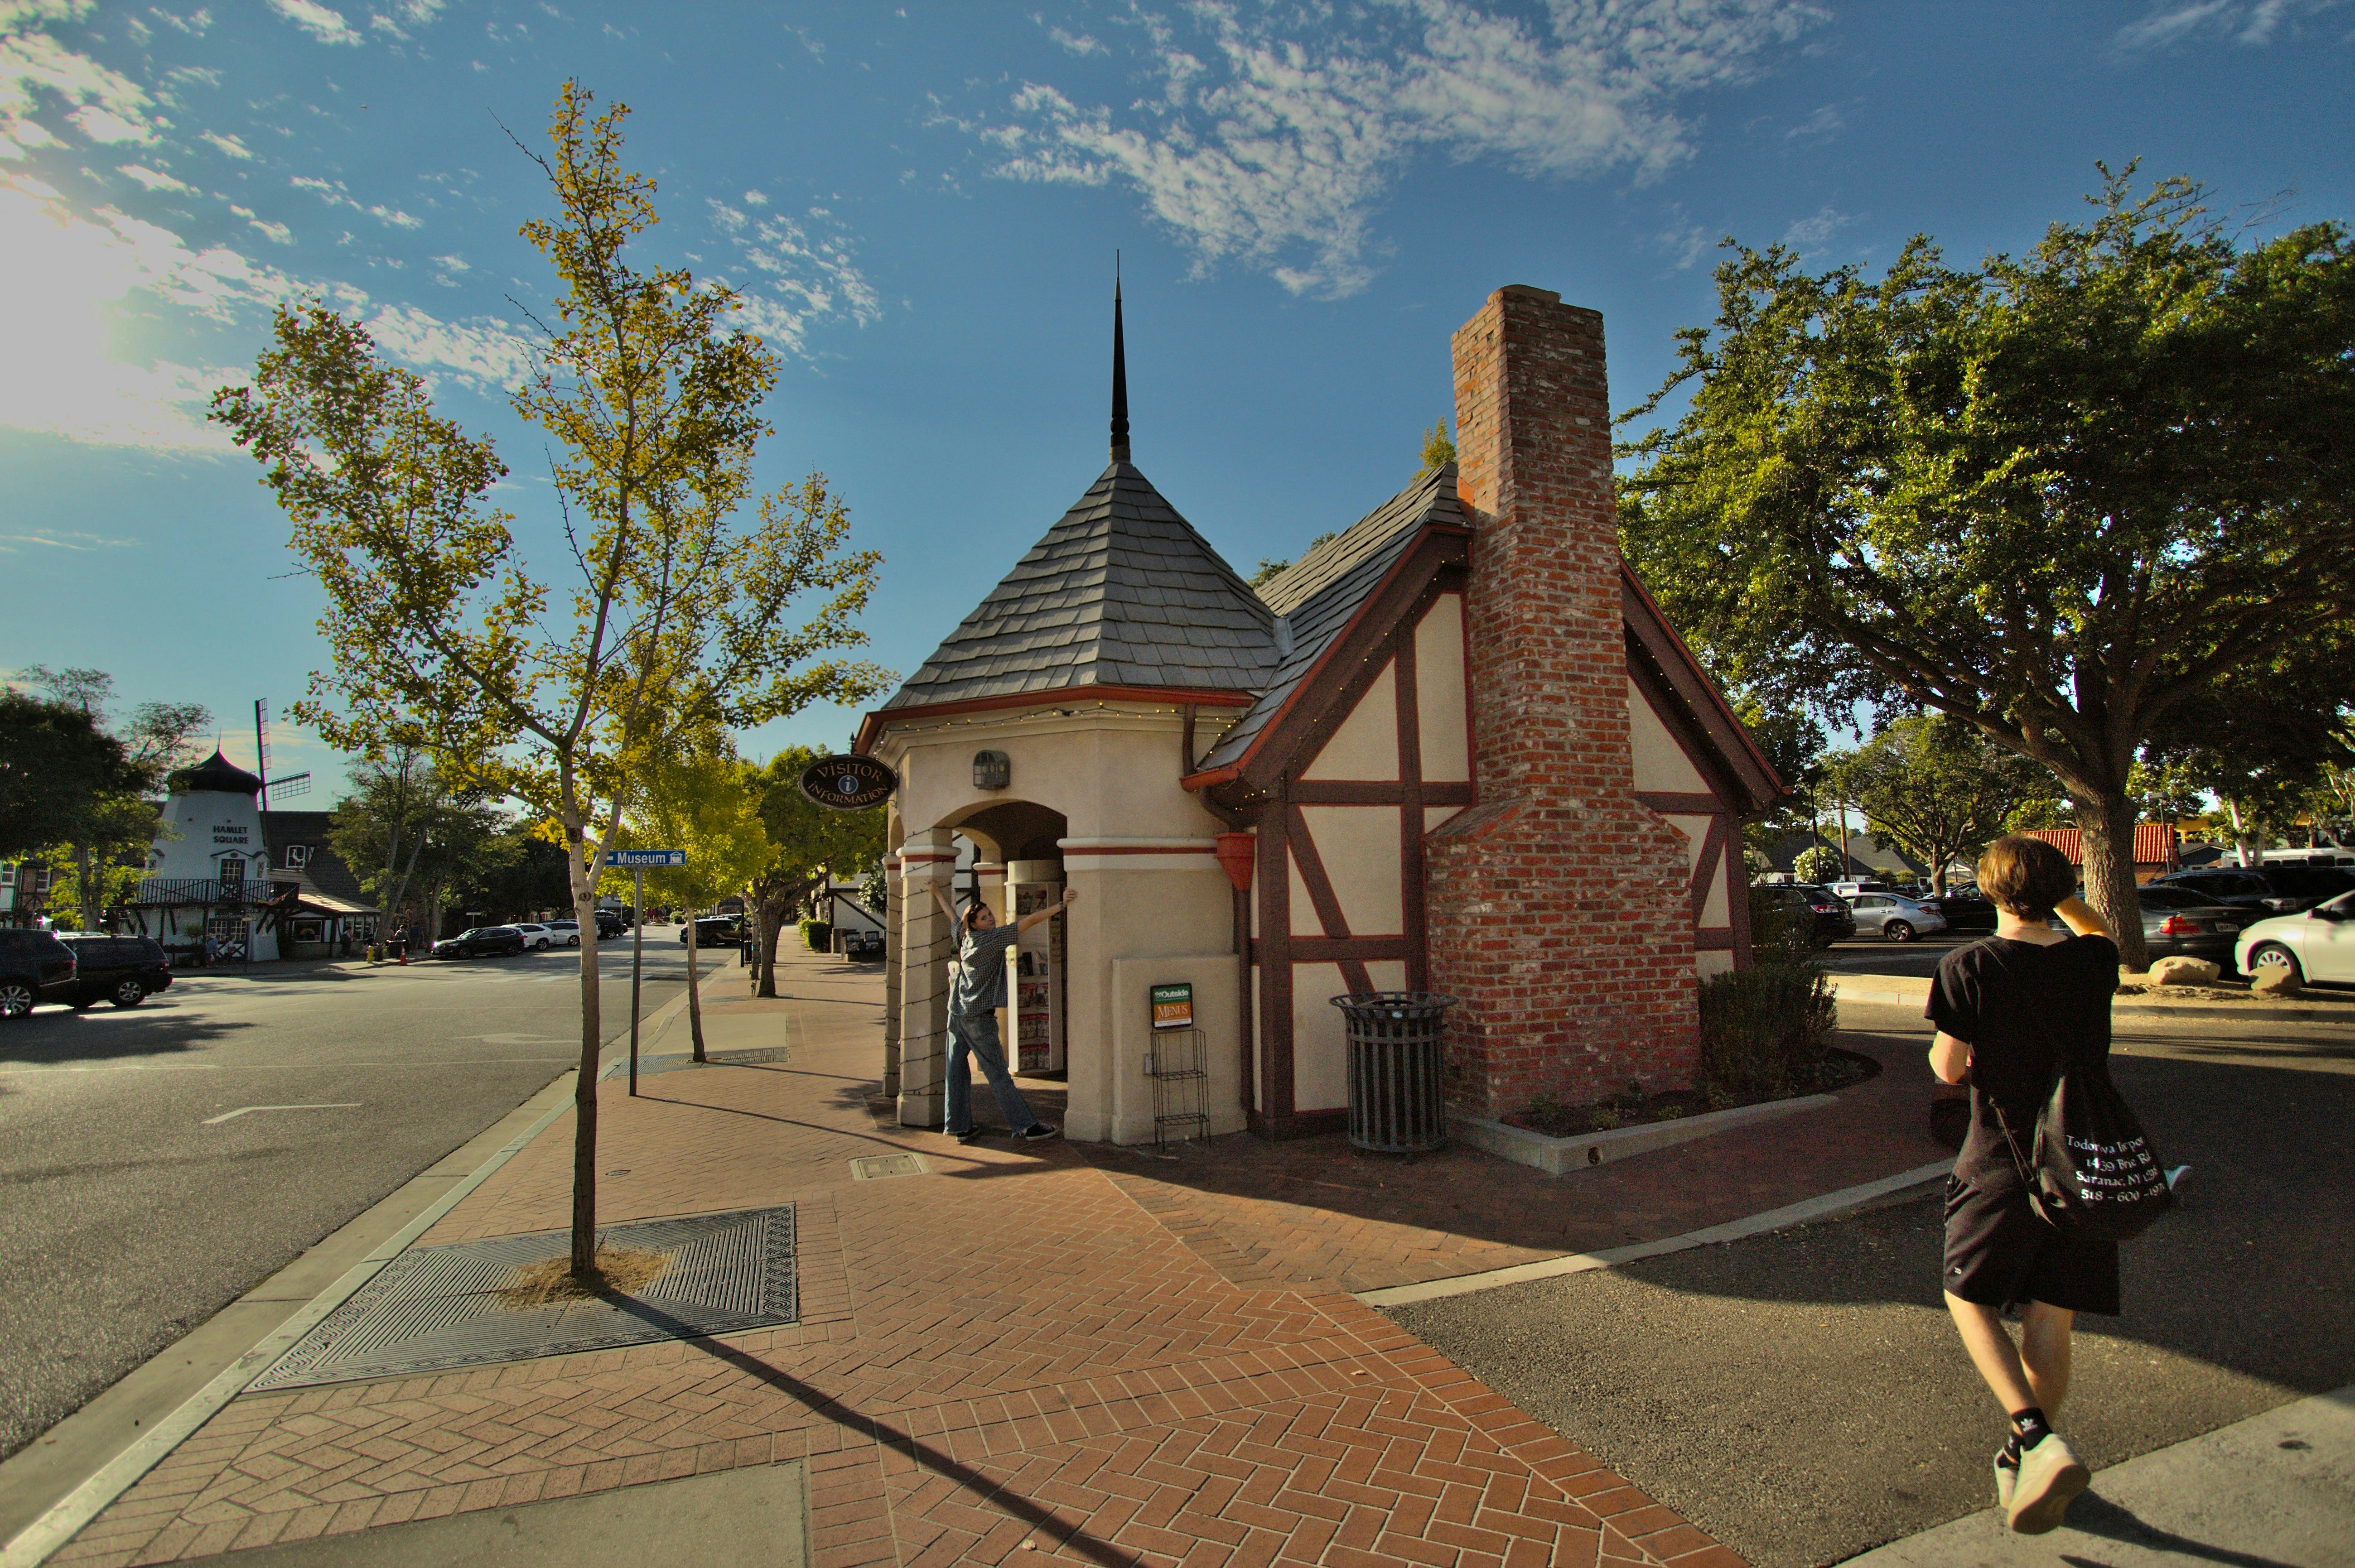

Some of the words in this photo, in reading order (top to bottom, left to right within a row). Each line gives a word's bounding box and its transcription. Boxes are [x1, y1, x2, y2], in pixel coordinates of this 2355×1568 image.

[817, 761, 882, 782] VISITOR
[808, 781, 888, 803] INFORMATION
[213, 825, 248, 833] HAMLET
[213, 836, 249, 844] SQUARE
[617, 852, 666, 864] Museum
[1158, 1005, 1188, 1018] MENUS
[2128, 1174, 2141, 1185] NY
[2080, 1188, 2103, 1201] 518
